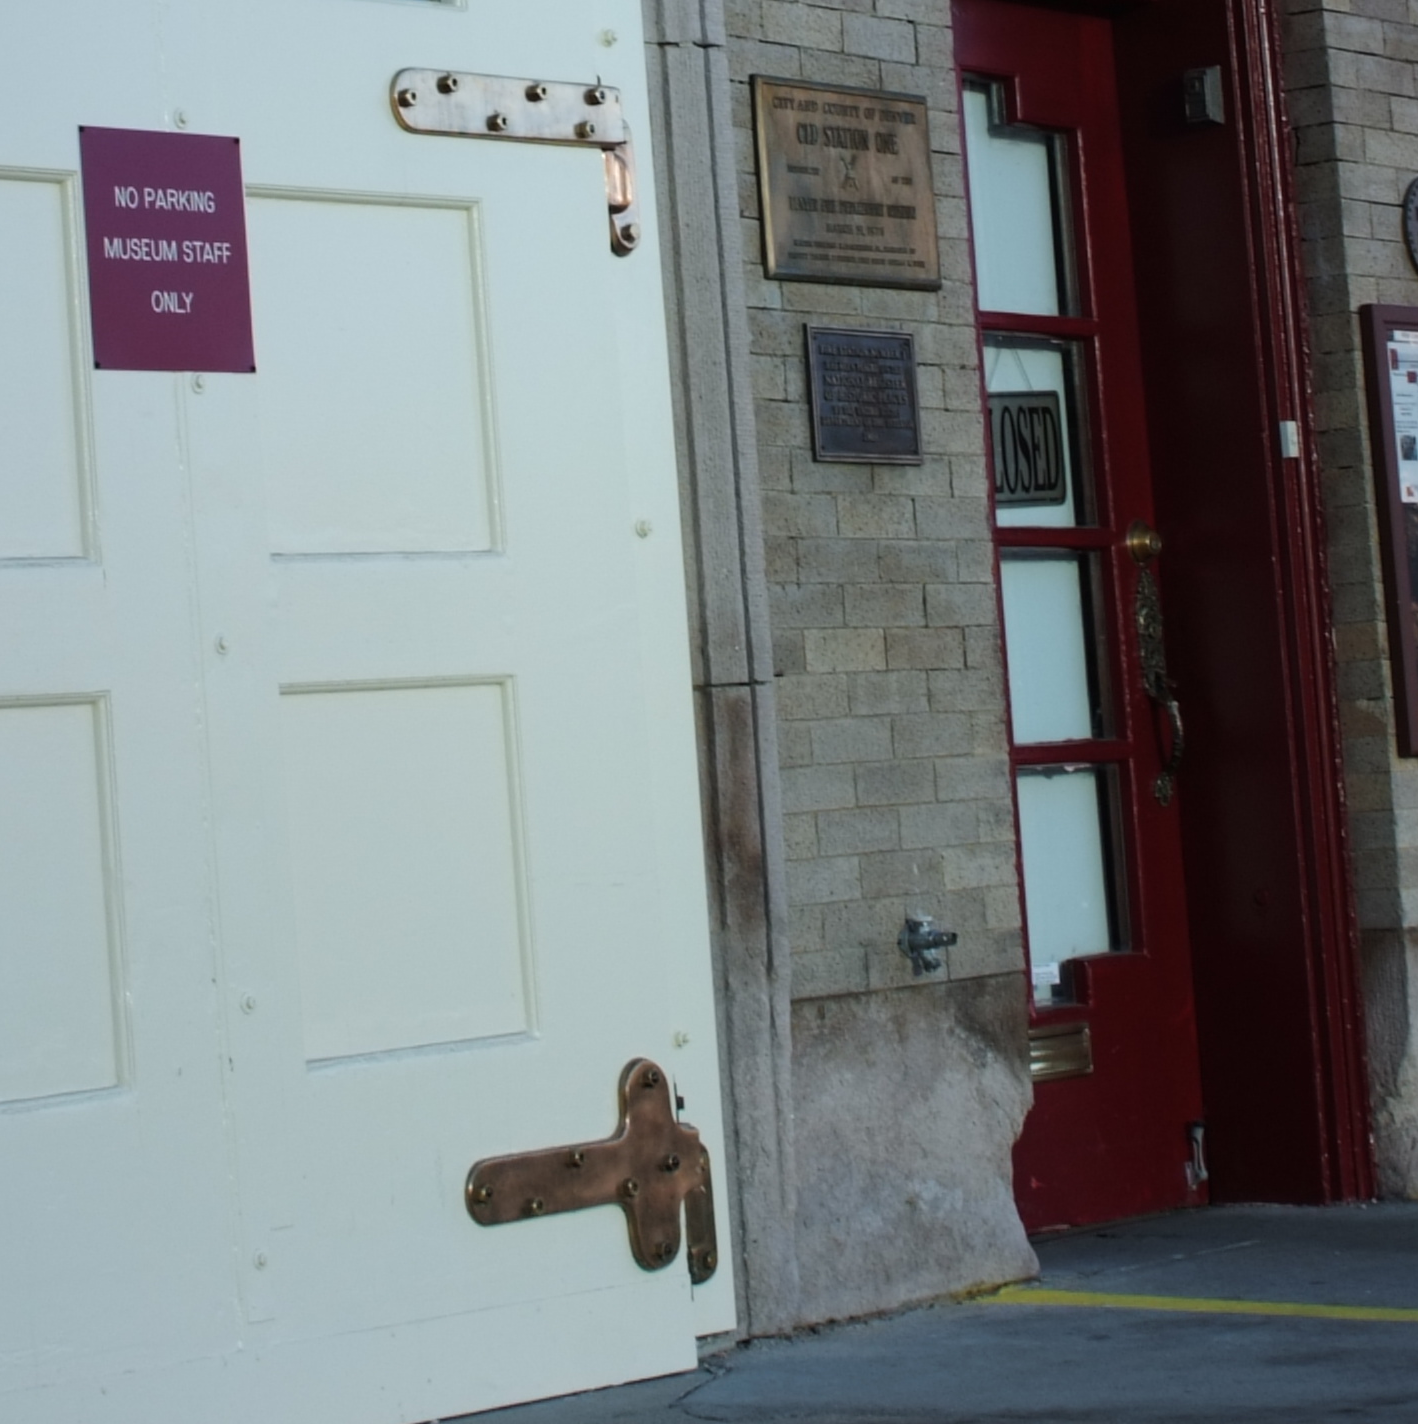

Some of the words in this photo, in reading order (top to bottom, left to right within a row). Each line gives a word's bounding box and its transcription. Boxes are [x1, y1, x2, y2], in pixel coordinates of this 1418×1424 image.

[822, 126, 870, 151] STATION
[114, 186, 139, 208] NO
[143, 187, 216, 213] PARKING
[103, 236, 178, 262] MUSEUM
[182, 240, 232, 264] STAFF
[151, 290, 194, 314] ONLY
[989, 404, 1059, 495] LOSED
